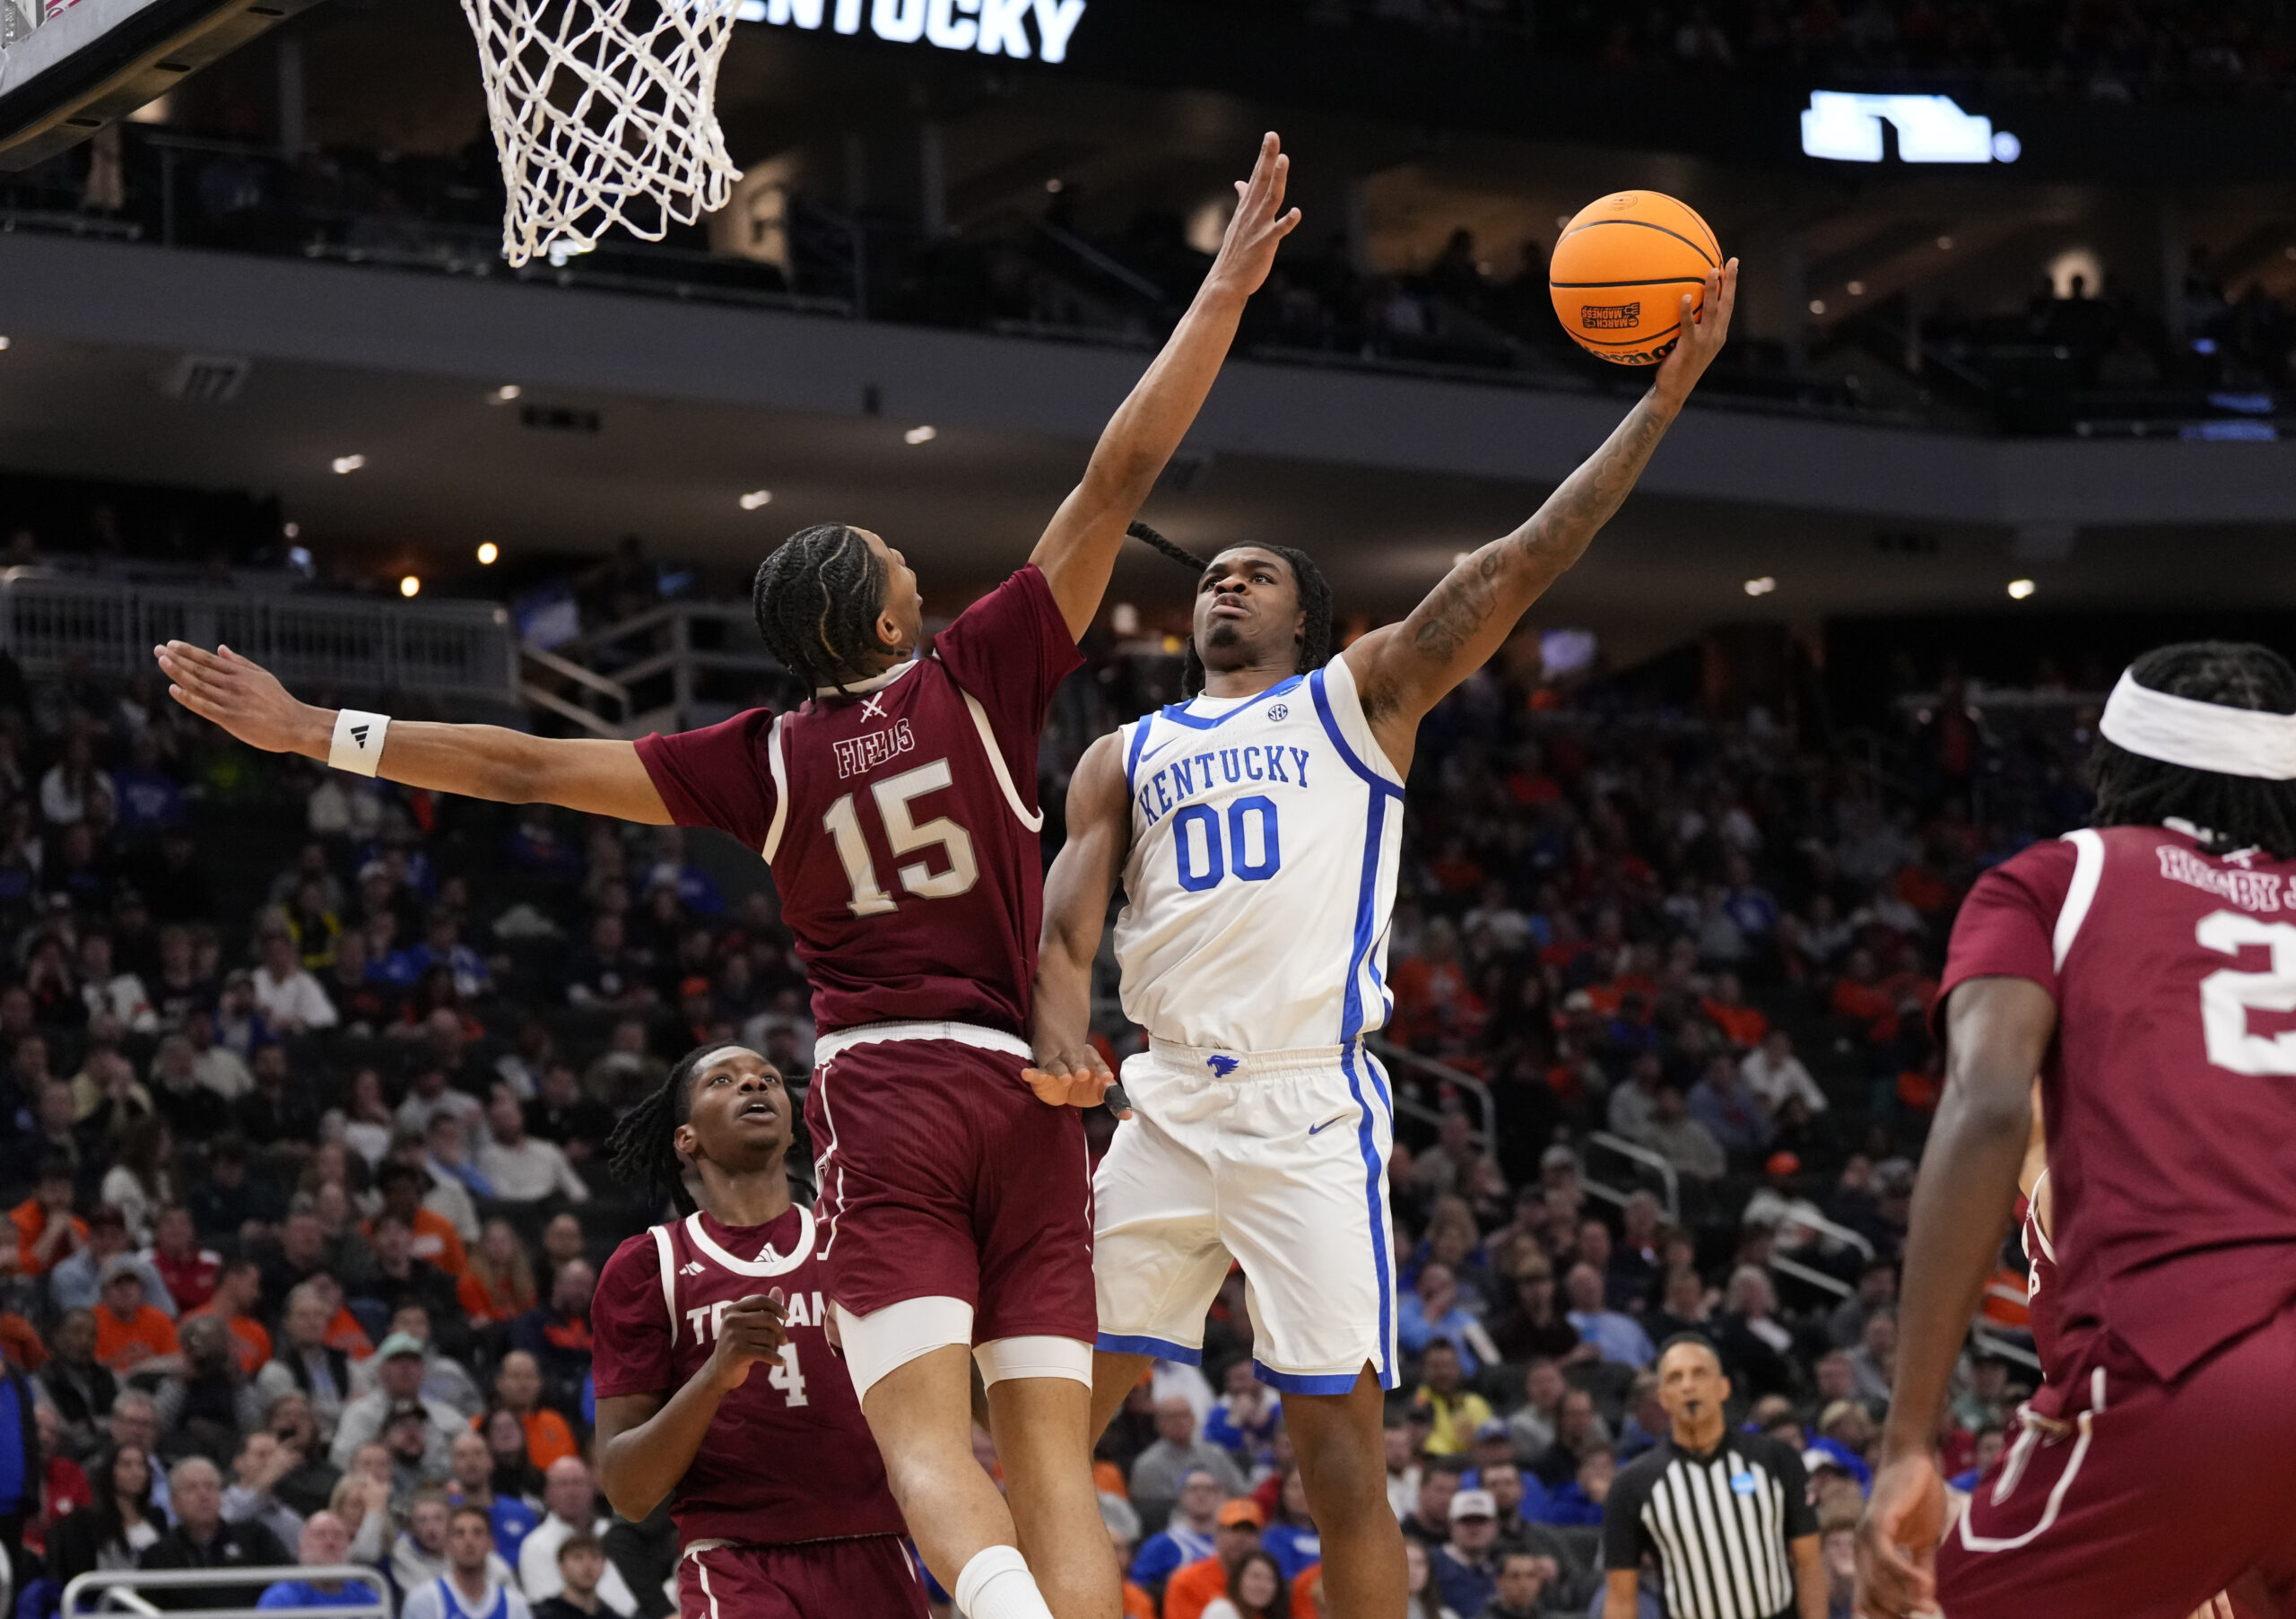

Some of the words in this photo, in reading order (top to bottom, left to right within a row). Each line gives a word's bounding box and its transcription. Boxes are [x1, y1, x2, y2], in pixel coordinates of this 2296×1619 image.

[1581, 308, 1622, 319] MADNESS
[1596, 318, 1629, 328] MARCH
[1268, 704, 1288, 721] SEC
[1138, 745, 1309, 827] KENTUCKY
[822, 757, 980, 919] 15
[1172, 796, 1281, 892] 00
[2196, 909, 2296, 1075] 2
[768, 1343, 809, 1407] 4
